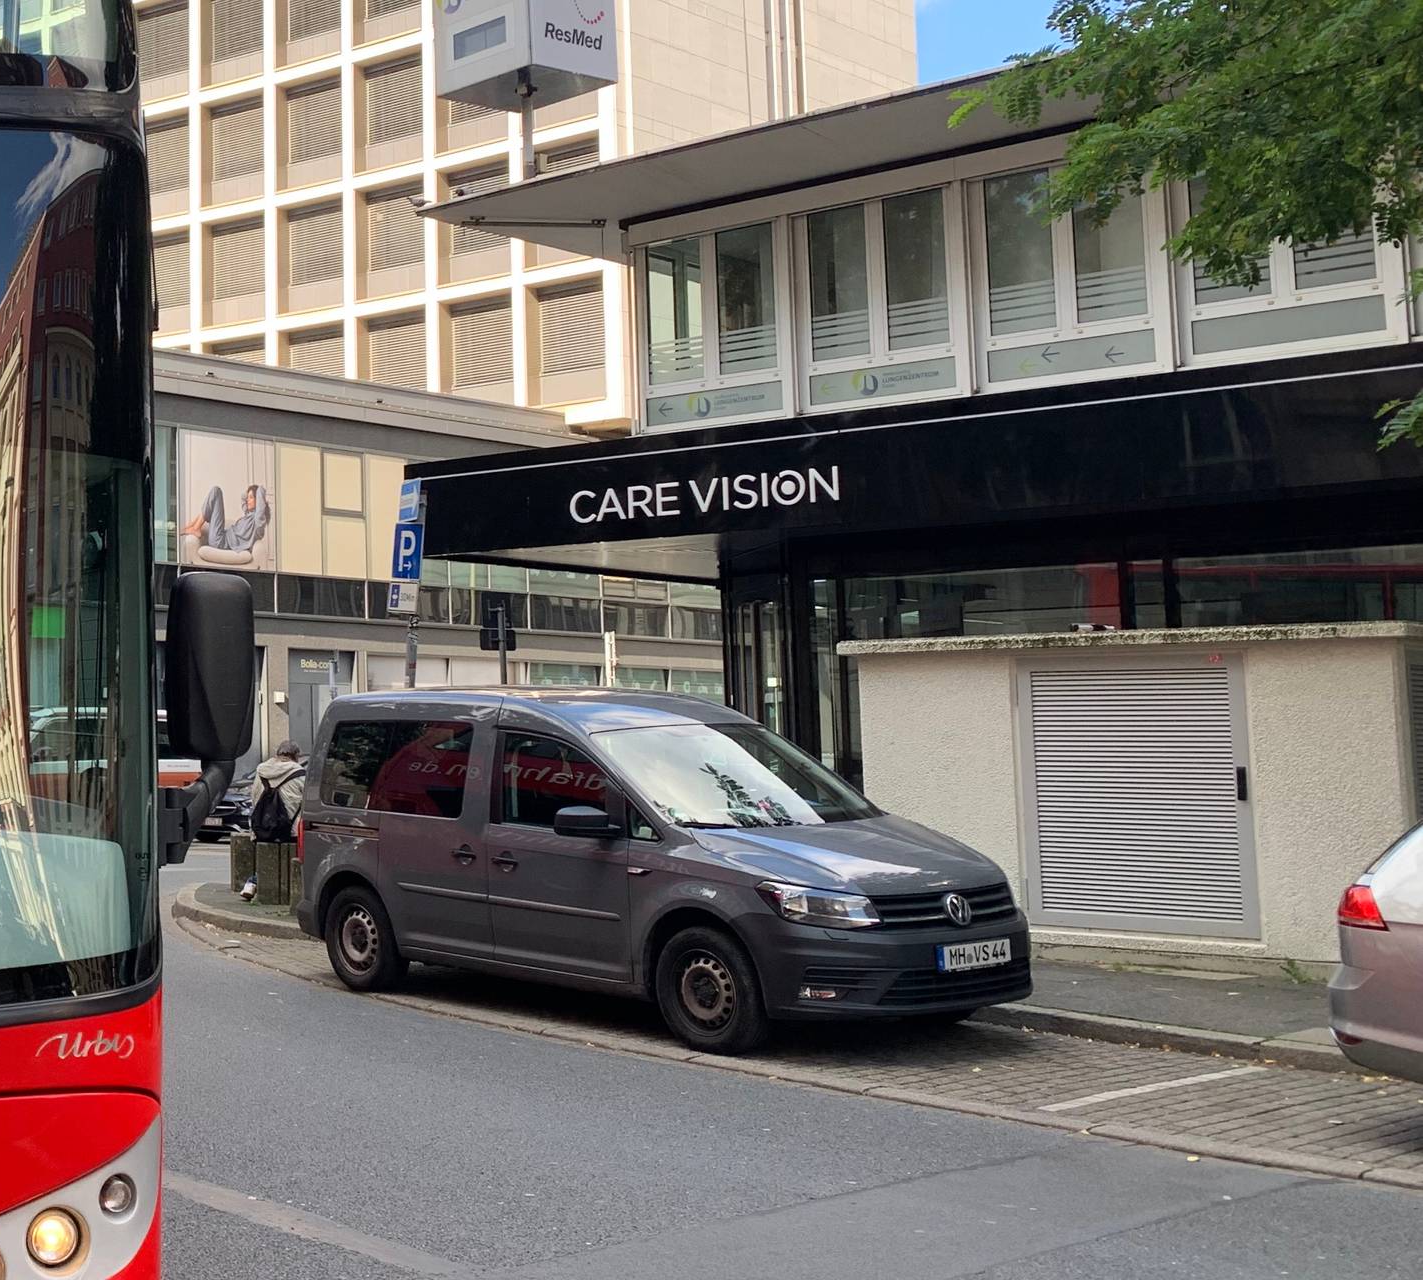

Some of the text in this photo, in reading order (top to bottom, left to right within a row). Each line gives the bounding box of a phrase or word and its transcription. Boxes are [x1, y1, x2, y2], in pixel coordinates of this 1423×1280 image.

[544, 22, 603, 51] ResMed
[569, 465, 840, 523] CARE VISION
[398, 530, 416, 572] P
[949, 941, 1006, 966] MH VS 44
